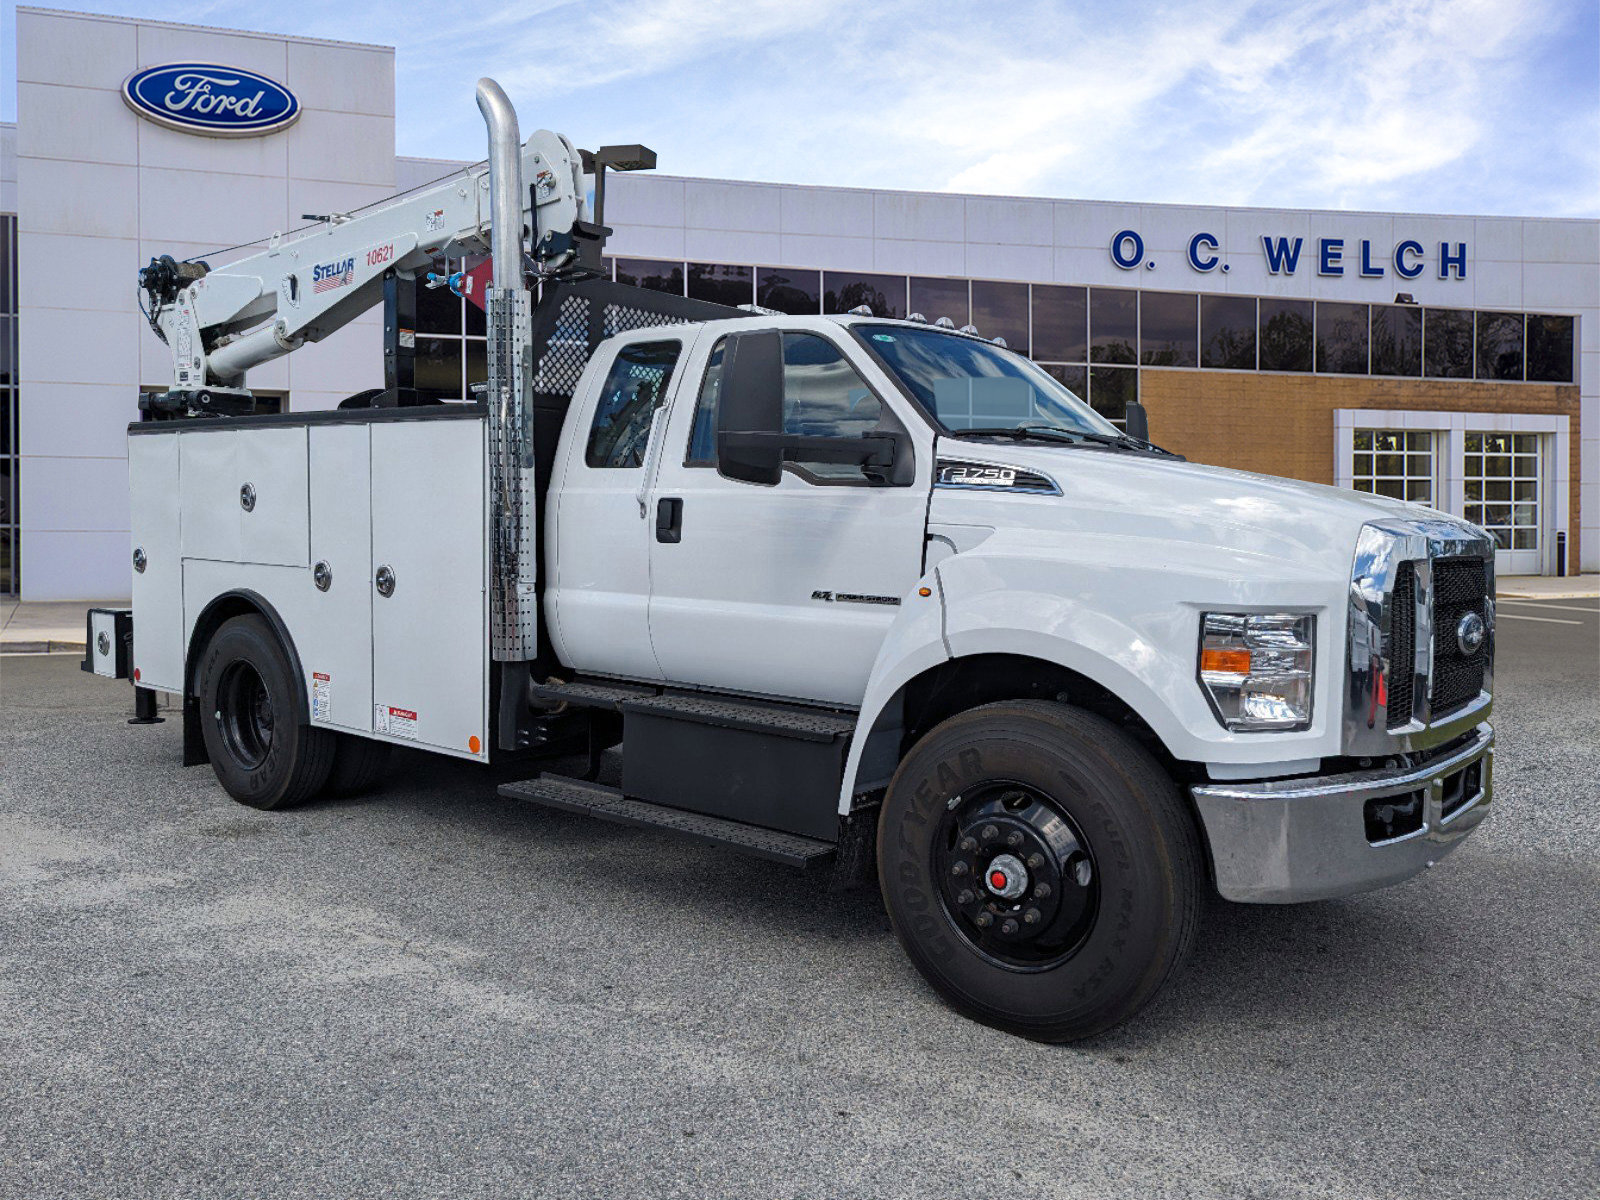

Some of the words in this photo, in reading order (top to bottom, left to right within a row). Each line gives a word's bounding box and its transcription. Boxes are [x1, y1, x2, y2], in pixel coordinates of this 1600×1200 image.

[164, 73, 266, 118] Ford
[312, 257, 355, 282] STELLAR
[366, 243, 395, 267] 10621
[1110, 229, 1156, 271] O.
[1187, 231, 1230, 273] C.
[1261, 234, 1468, 281] WELCH
